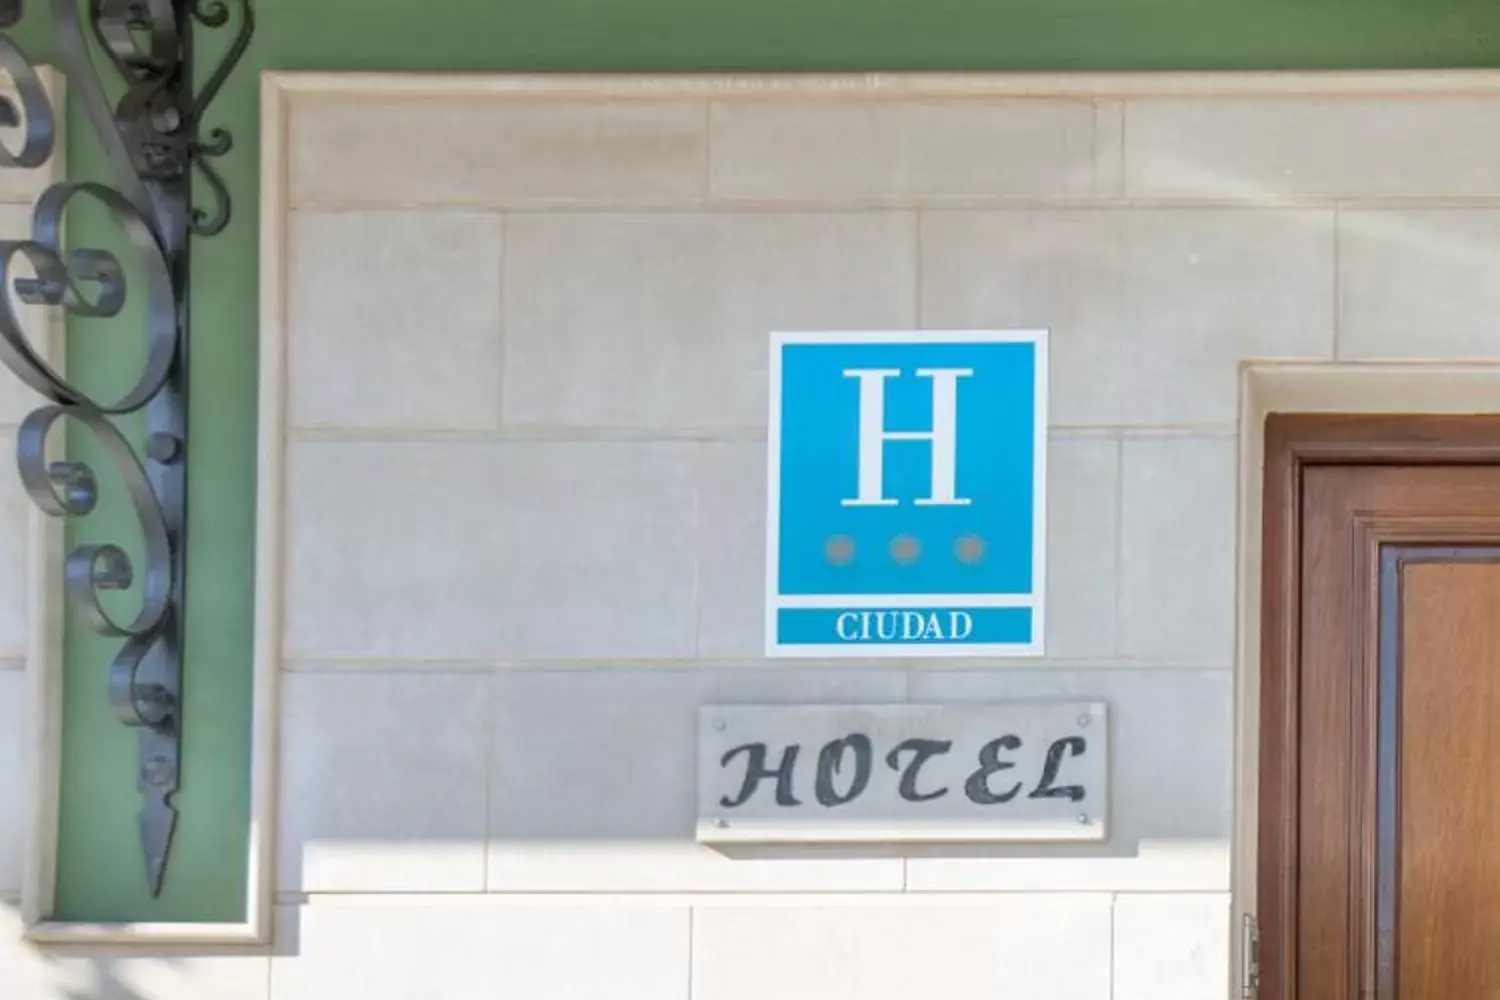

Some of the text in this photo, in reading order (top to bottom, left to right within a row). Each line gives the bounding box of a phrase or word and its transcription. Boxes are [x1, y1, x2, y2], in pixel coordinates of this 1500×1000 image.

[840, 368, 973, 506] H
[836, 611, 973, 641] CIUDAD
[719, 733, 1087, 808] HOTEL
